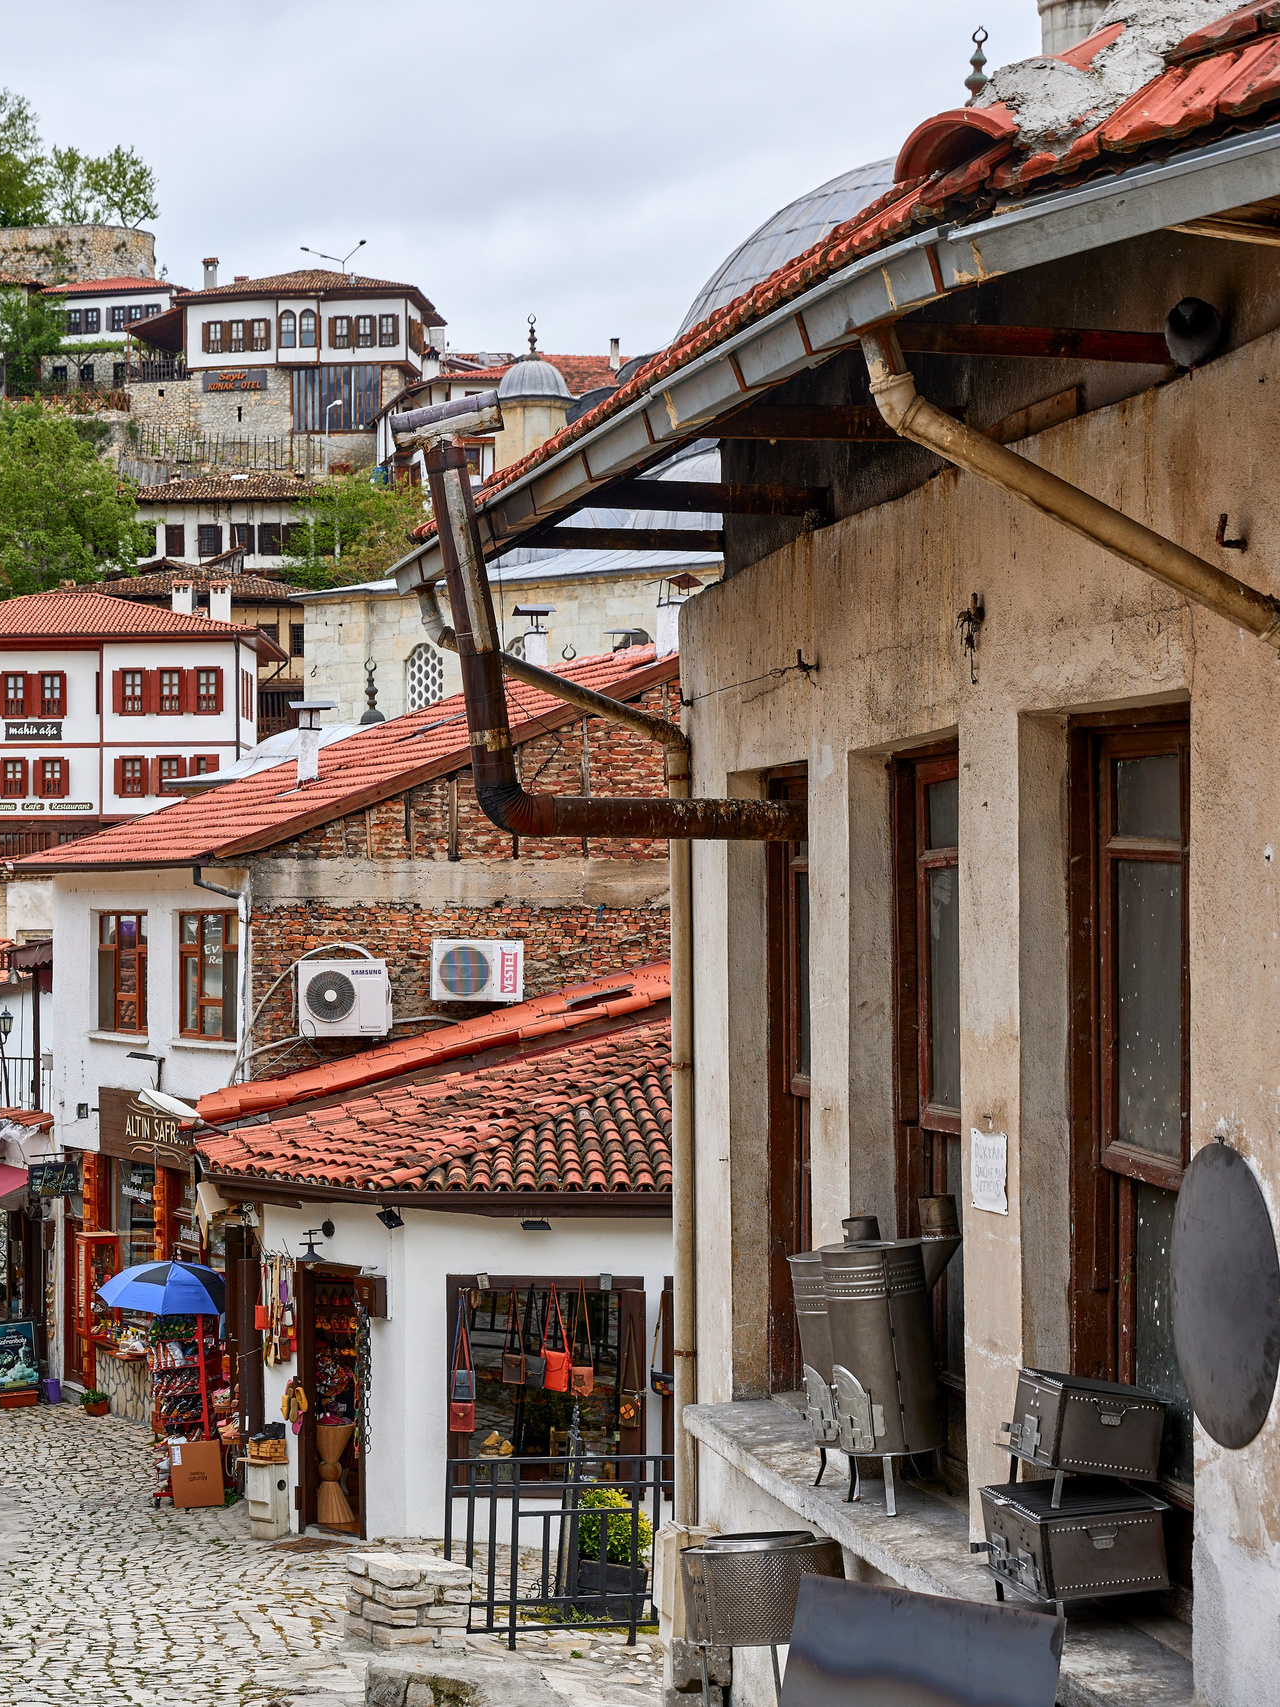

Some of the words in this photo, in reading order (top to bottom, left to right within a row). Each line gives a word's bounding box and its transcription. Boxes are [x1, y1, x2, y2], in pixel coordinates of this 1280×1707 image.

[208, 382, 234, 390] KONAK
[241, 381, 261, 389] OTEL
[9, 723, 37, 735] mahir
[39, 724, 58, 737] ağa
[23, 803, 41, 811] Cafe
[503, 953, 515, 993] VESTEL
[125, 1114, 151, 1139] ALTIN
[154, 1118, 189, 1146] SAFR
